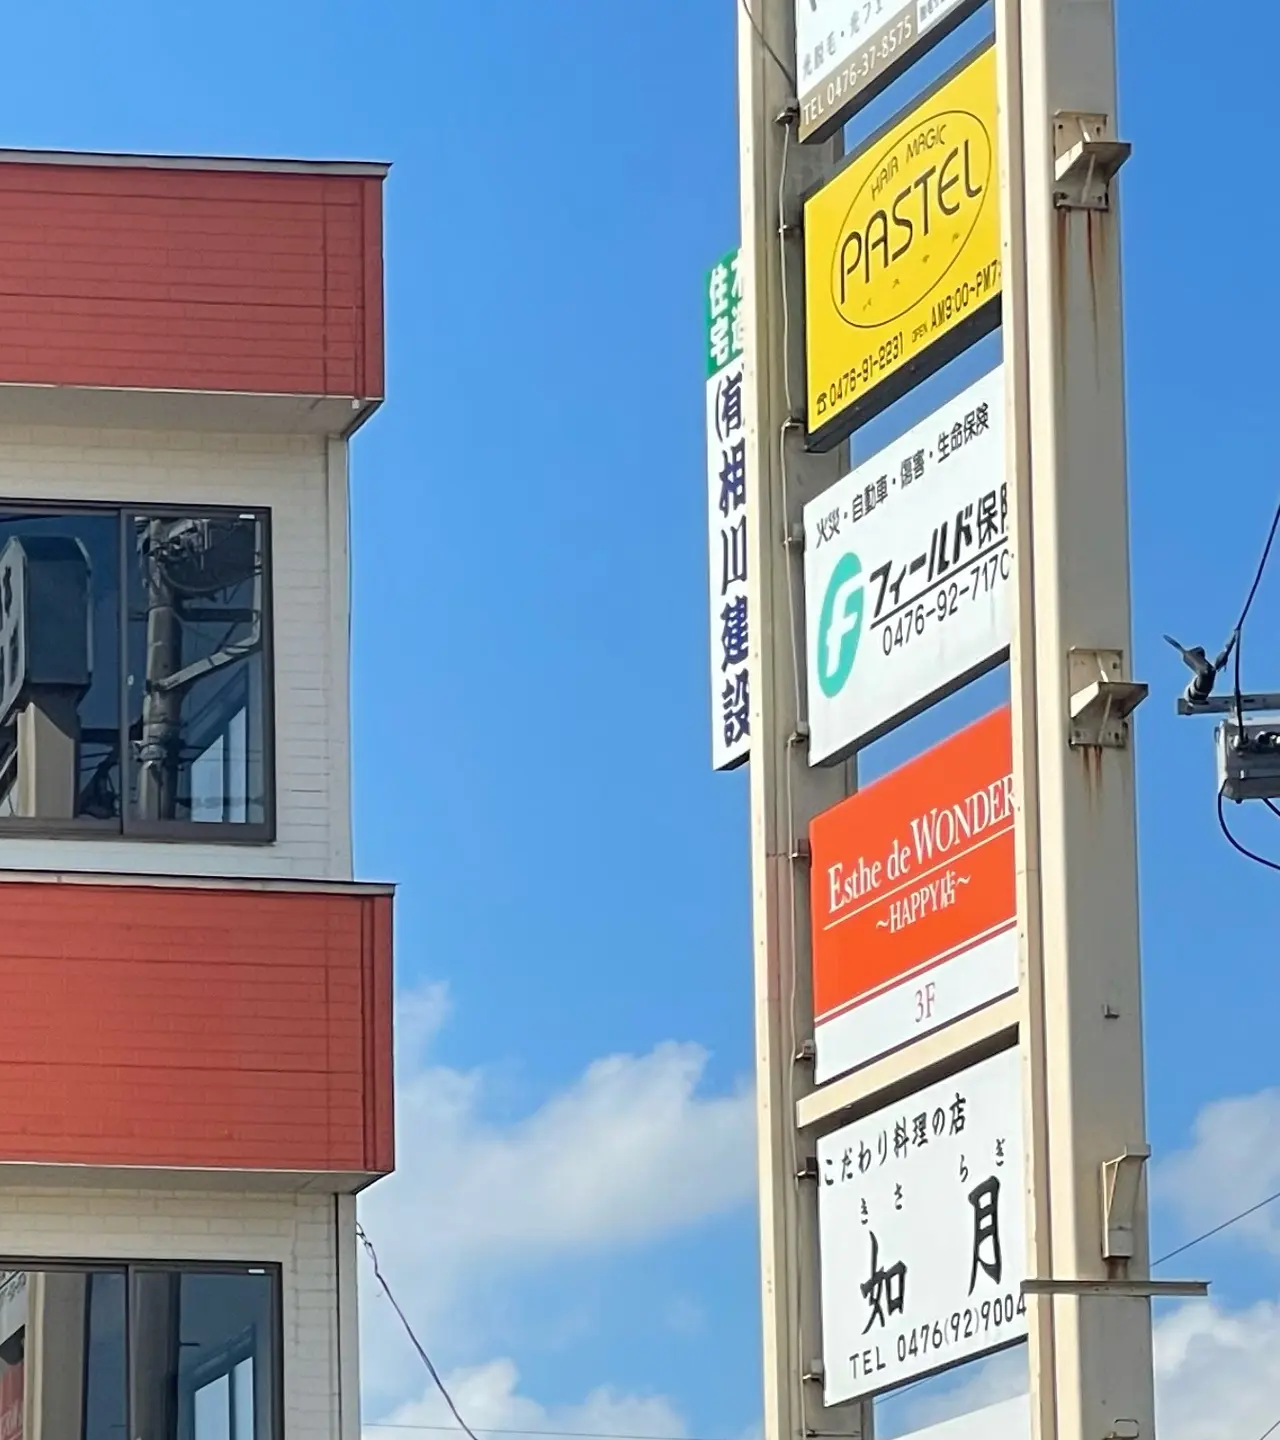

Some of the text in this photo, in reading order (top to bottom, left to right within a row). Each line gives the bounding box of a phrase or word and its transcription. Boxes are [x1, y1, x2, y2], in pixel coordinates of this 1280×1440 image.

[803, 15, 912, 125] TEL 0476-37-8575
[871, 124, 946, 201] HAIR MAGIC
[841, 139, 982, 304] PASTEL
[828, 772, 1016, 913] Esthe de WONDER
[914, 982, 936, 1023] 3F
[825, 1092, 967, 1186] こだわり料理の店
[850, 1294, 1027, 1379] TEL 0476(92)9004
